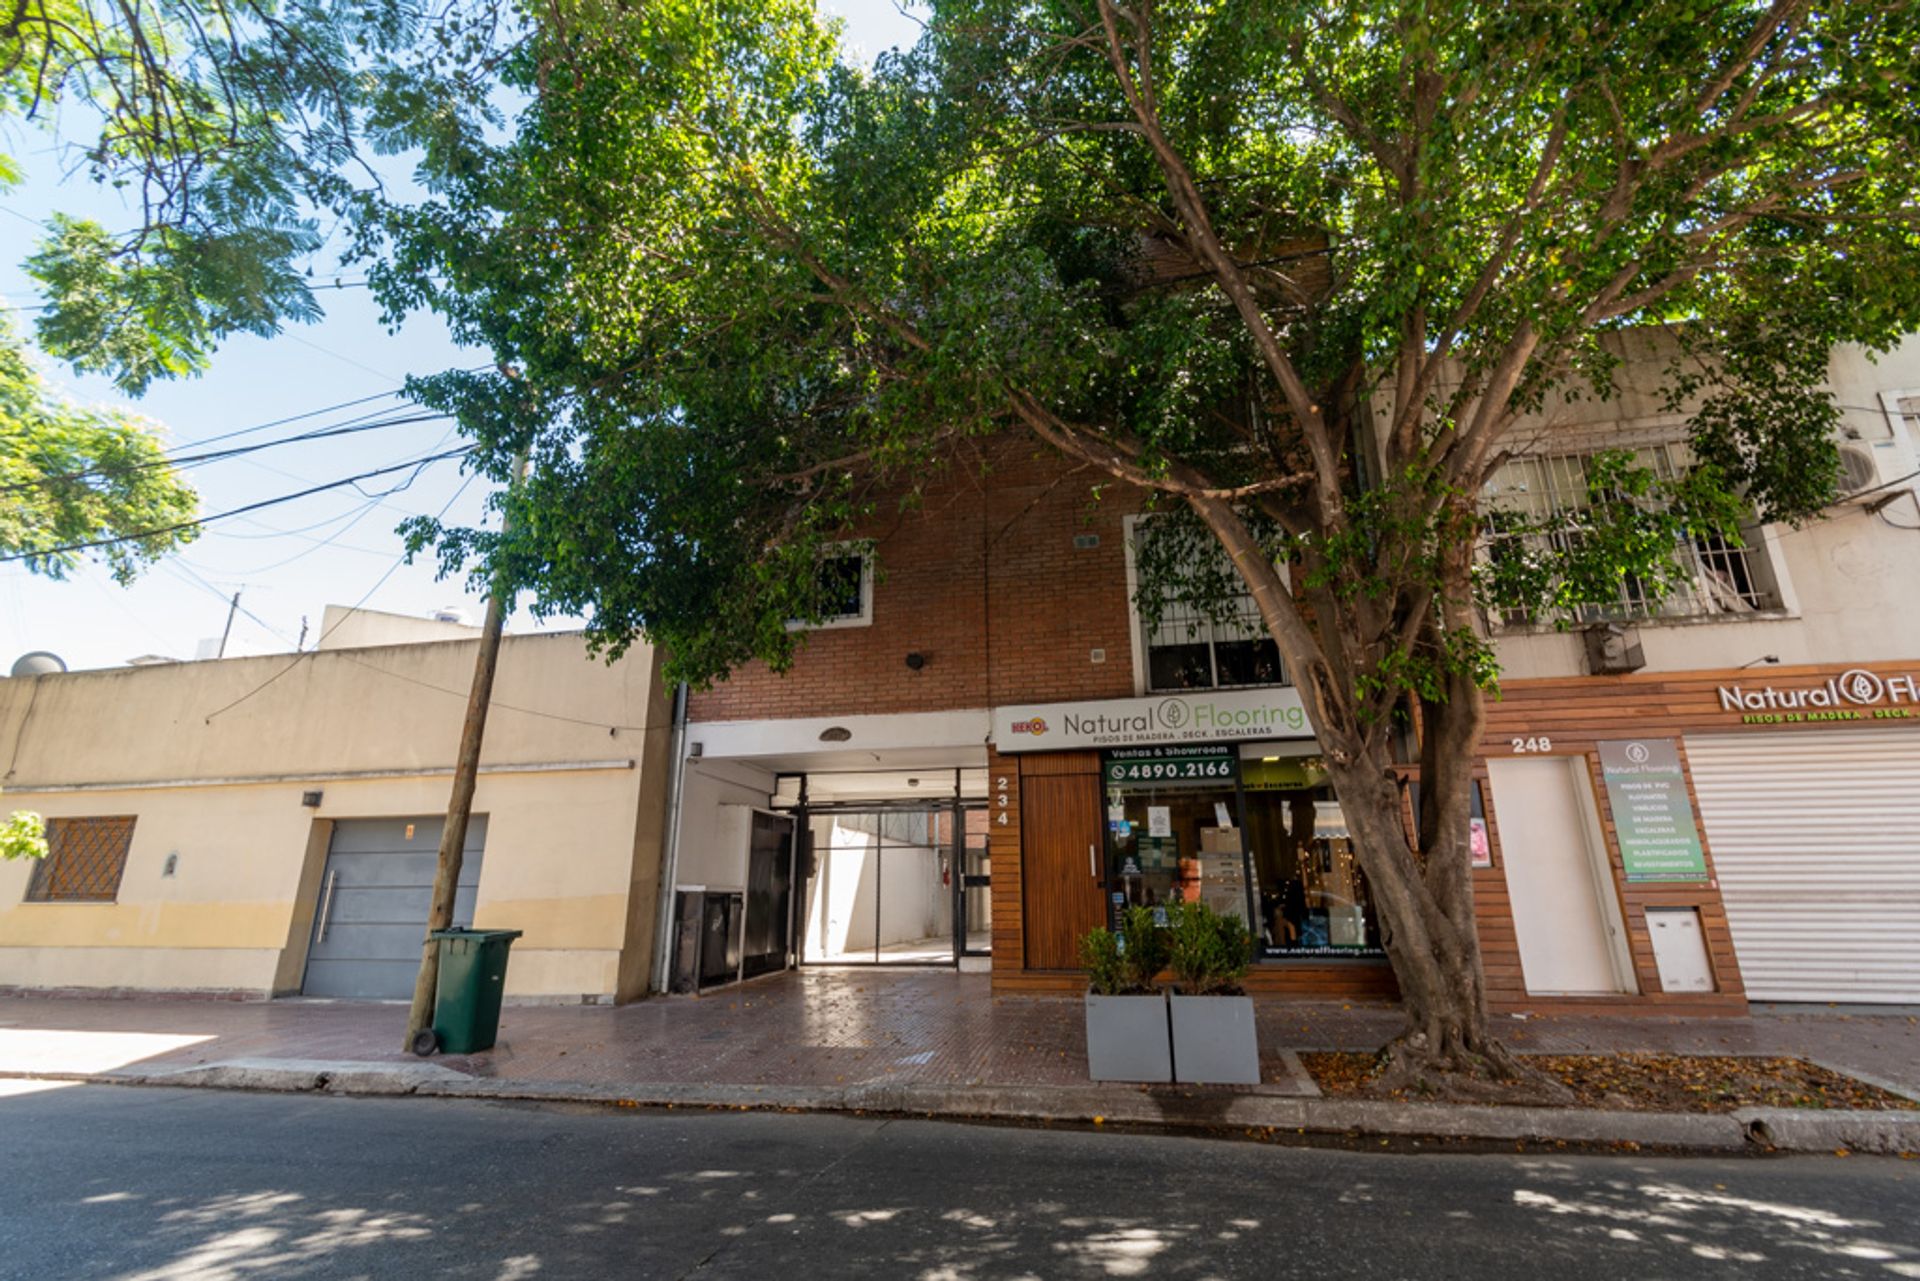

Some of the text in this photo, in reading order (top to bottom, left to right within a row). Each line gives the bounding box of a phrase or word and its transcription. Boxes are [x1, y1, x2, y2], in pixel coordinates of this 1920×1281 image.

[1718, 675, 1920, 711] Natural Fl
[1064, 704, 1305, 735] Natural Flooring
[1743, 708, 1910, 724] PISOS DE MADERA DECK
[1011, 719, 1049, 735] HEKOL
[1093, 727, 1272, 743] PISOS DE MADERA DECK ESCALERAS
[1111, 746, 1228, 758] Ventas & Showroom
[1512, 736, 1552, 752] 248
[1128, 761, 1230, 778] 4890.2166
